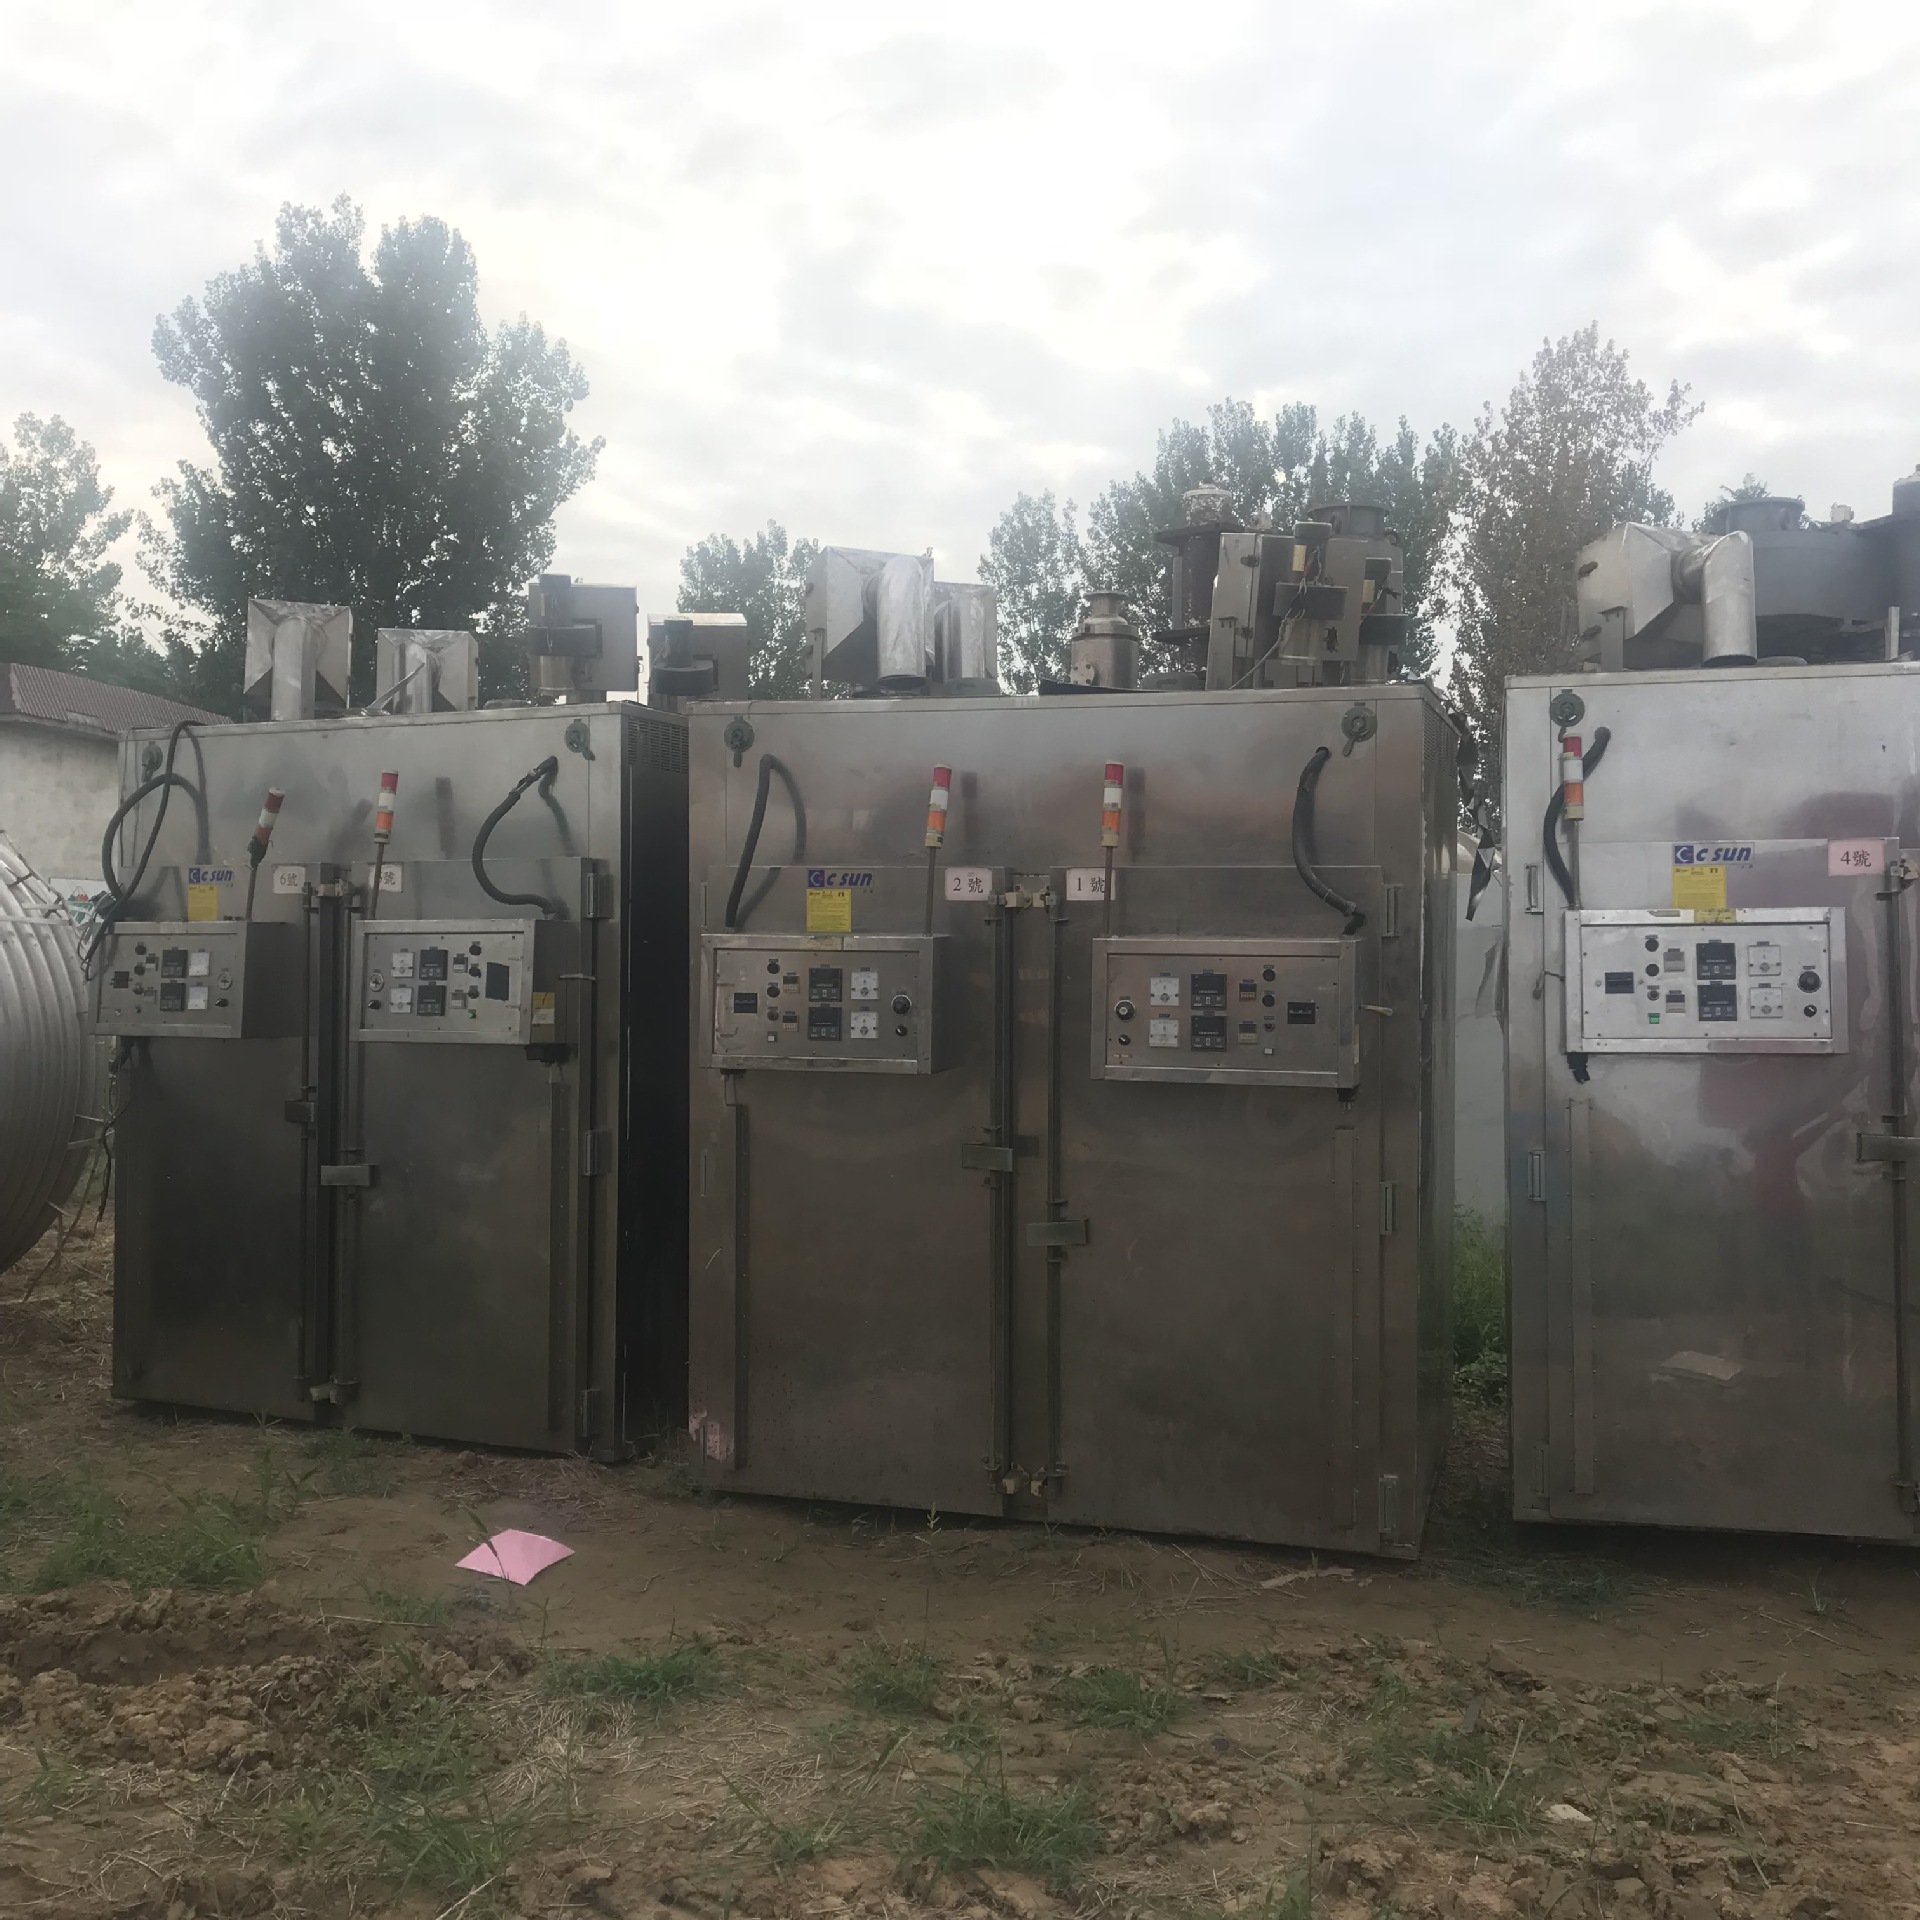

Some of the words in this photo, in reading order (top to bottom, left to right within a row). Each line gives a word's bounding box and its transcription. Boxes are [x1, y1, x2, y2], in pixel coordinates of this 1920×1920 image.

[1840, 850, 1872, 867] 4號
[280, 872, 298, 887] 6號
[952, 876, 984, 894] 2號
